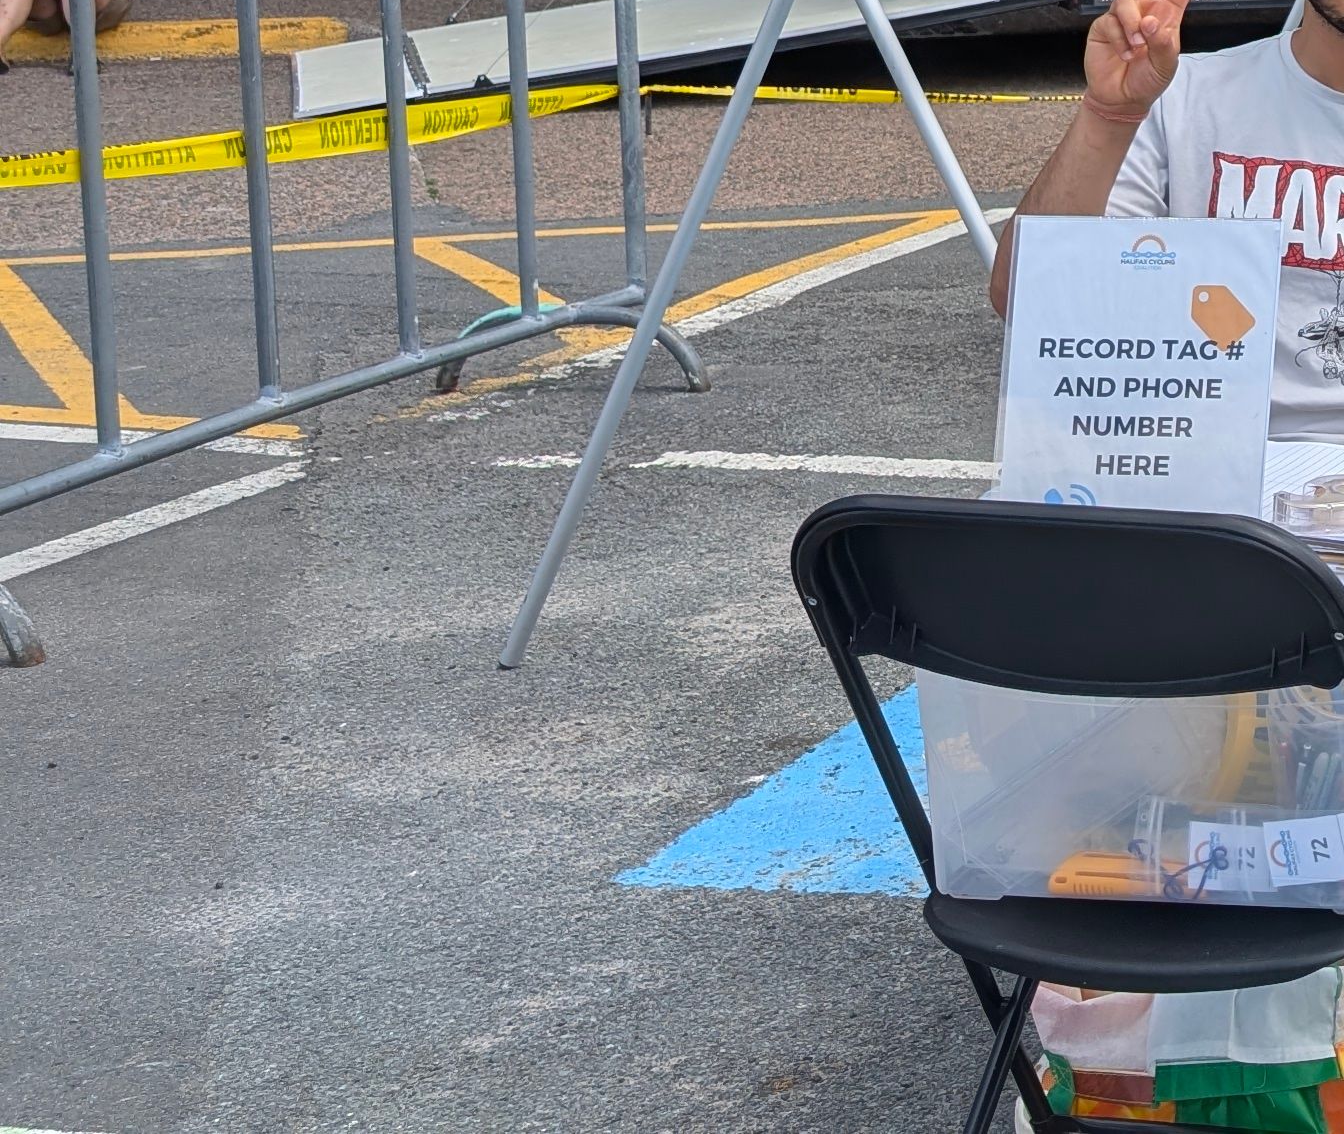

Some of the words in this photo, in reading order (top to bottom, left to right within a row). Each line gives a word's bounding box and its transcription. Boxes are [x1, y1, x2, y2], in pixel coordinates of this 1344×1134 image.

[1039, 337, 1155, 359] RECORD
[1162, 339, 1218, 361] TAG
[1225, 340, 1245, 361] #
[1053, 376, 1117, 398] AND
[1123, 377, 1223, 399] PHONE
[1071, 415, 1194, 437] NUMBER
[1095, 454, 1170, 476] HERE
[1311, 836, 1331, 863] 72
